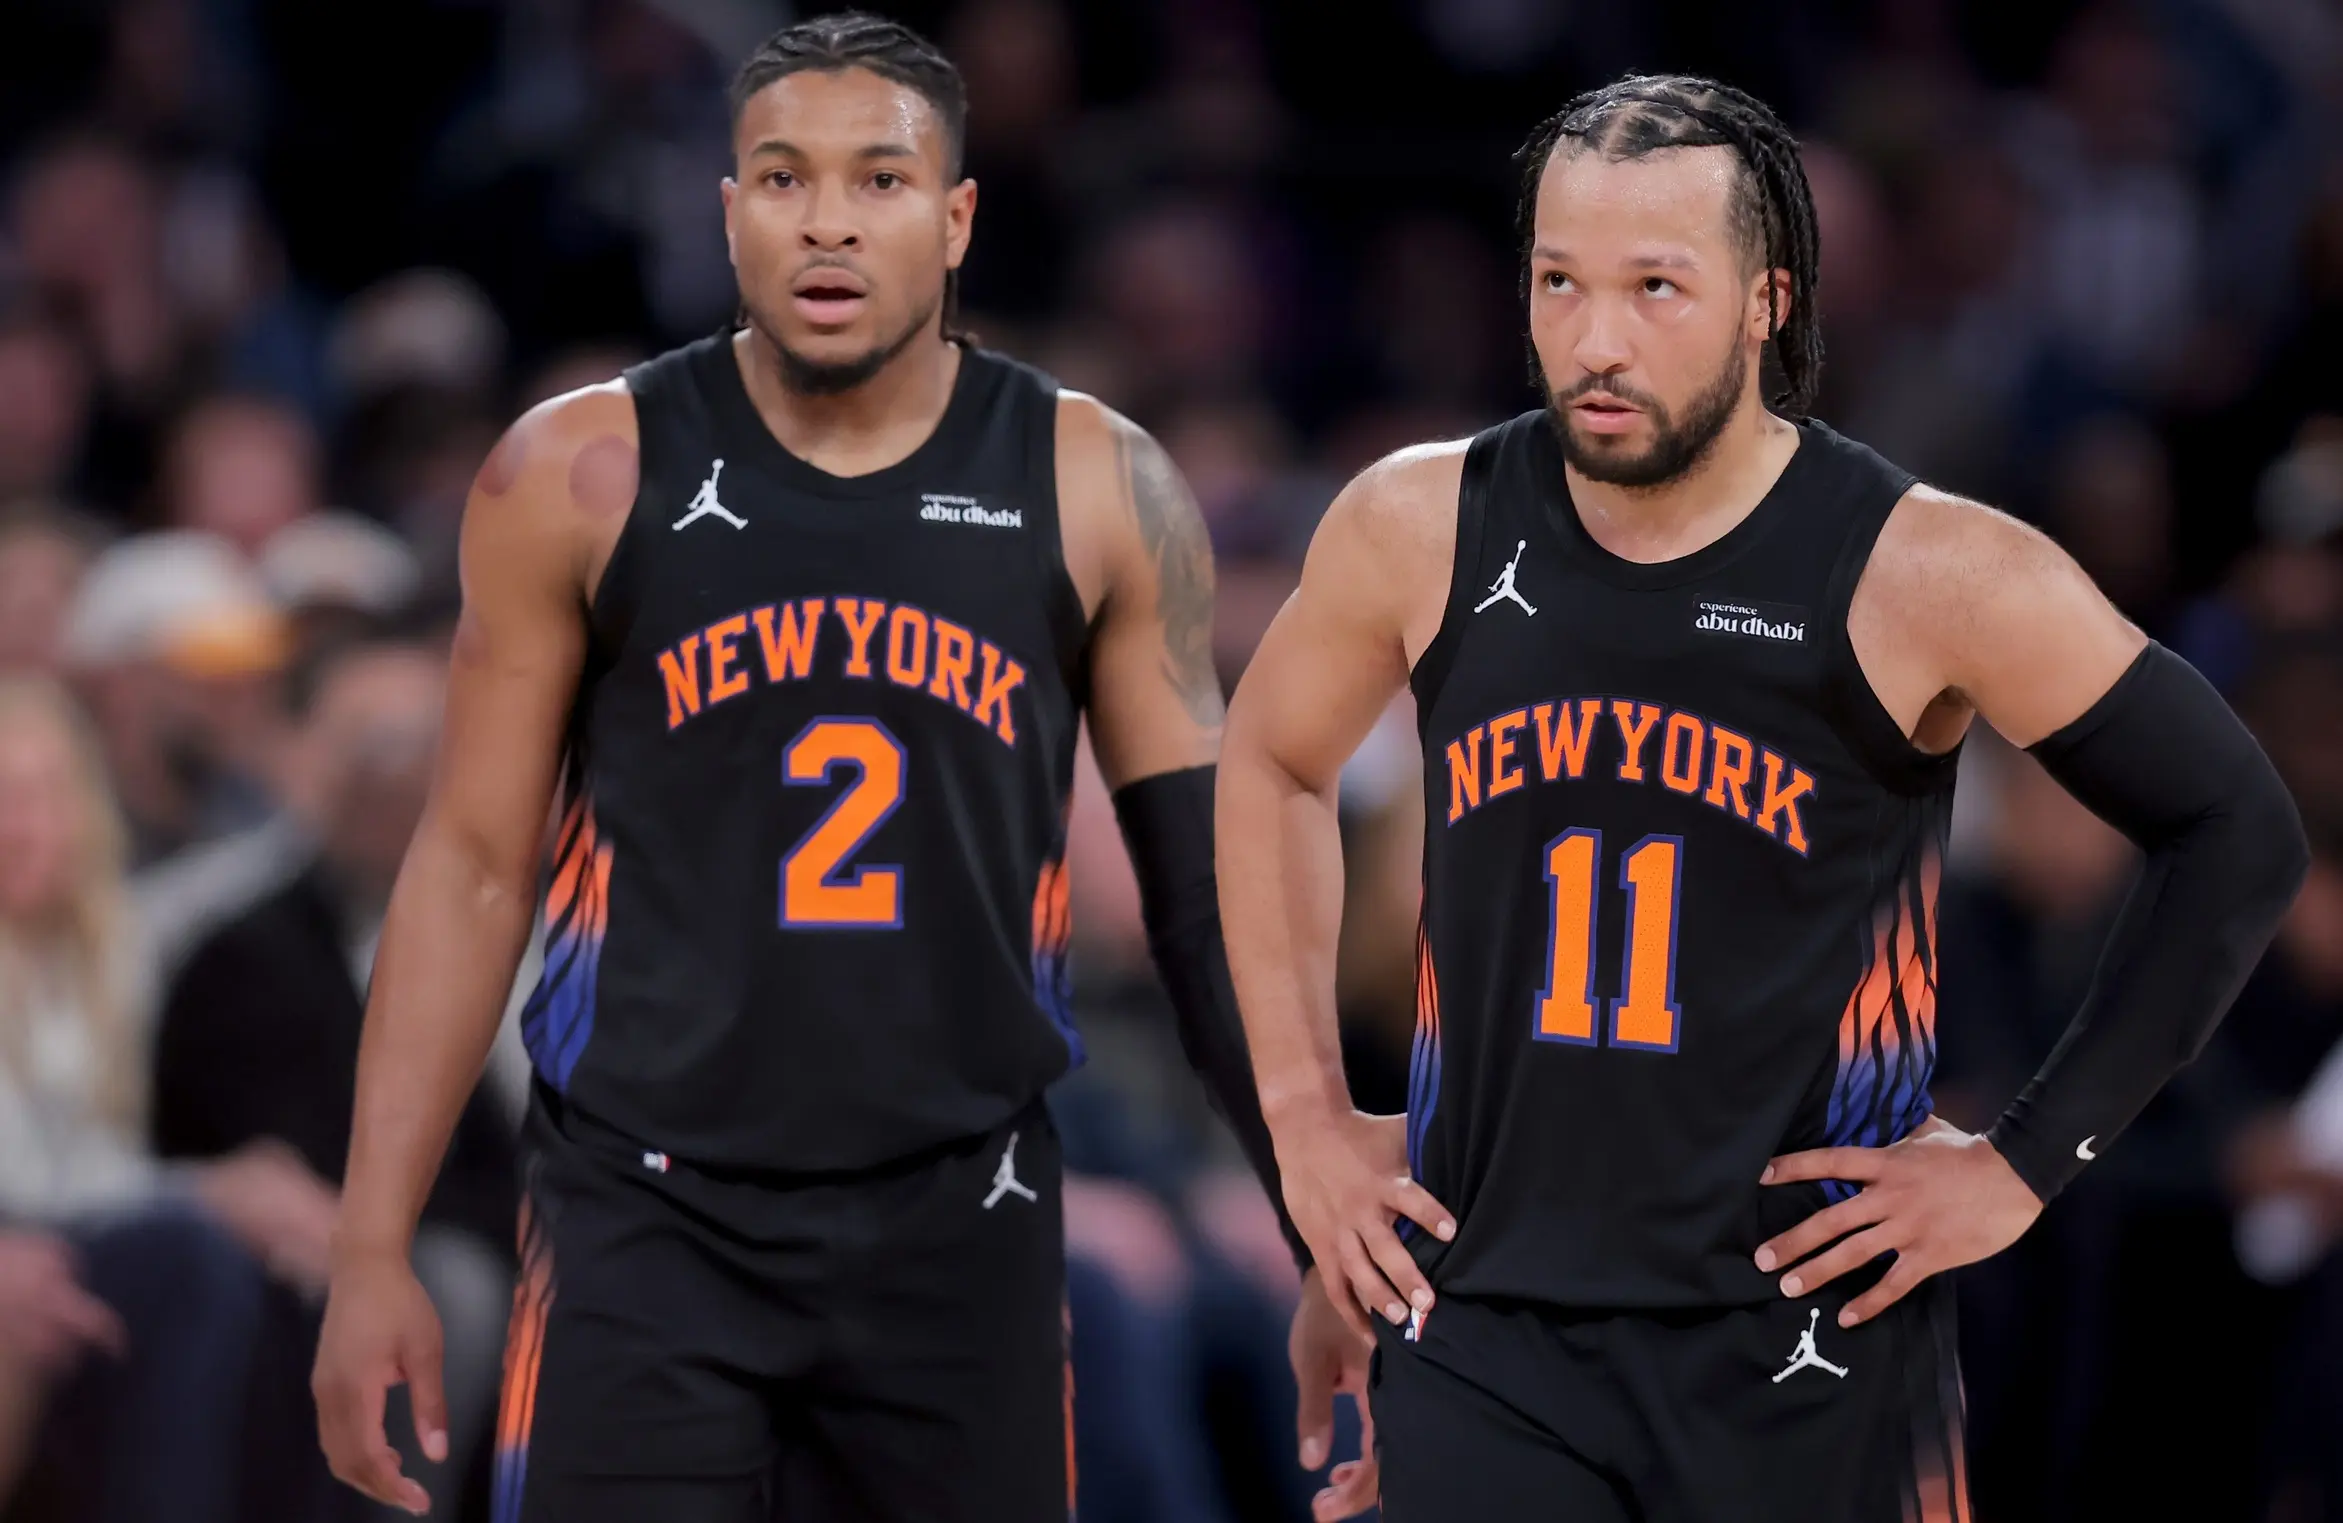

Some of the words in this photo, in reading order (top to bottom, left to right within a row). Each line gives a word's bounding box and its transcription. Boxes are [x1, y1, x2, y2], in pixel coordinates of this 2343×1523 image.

[656, 598, 825, 732] NEW
[833, 597, 1026, 747] YORK
[1695, 612, 1738, 633] abu
[1700, 601, 1758, 615] experience
[778, 715, 908, 930] 2
[1446, 697, 1602, 828] NEW
[1610, 698, 1820, 859] YORK
[1532, 826, 1684, 1055] 11
